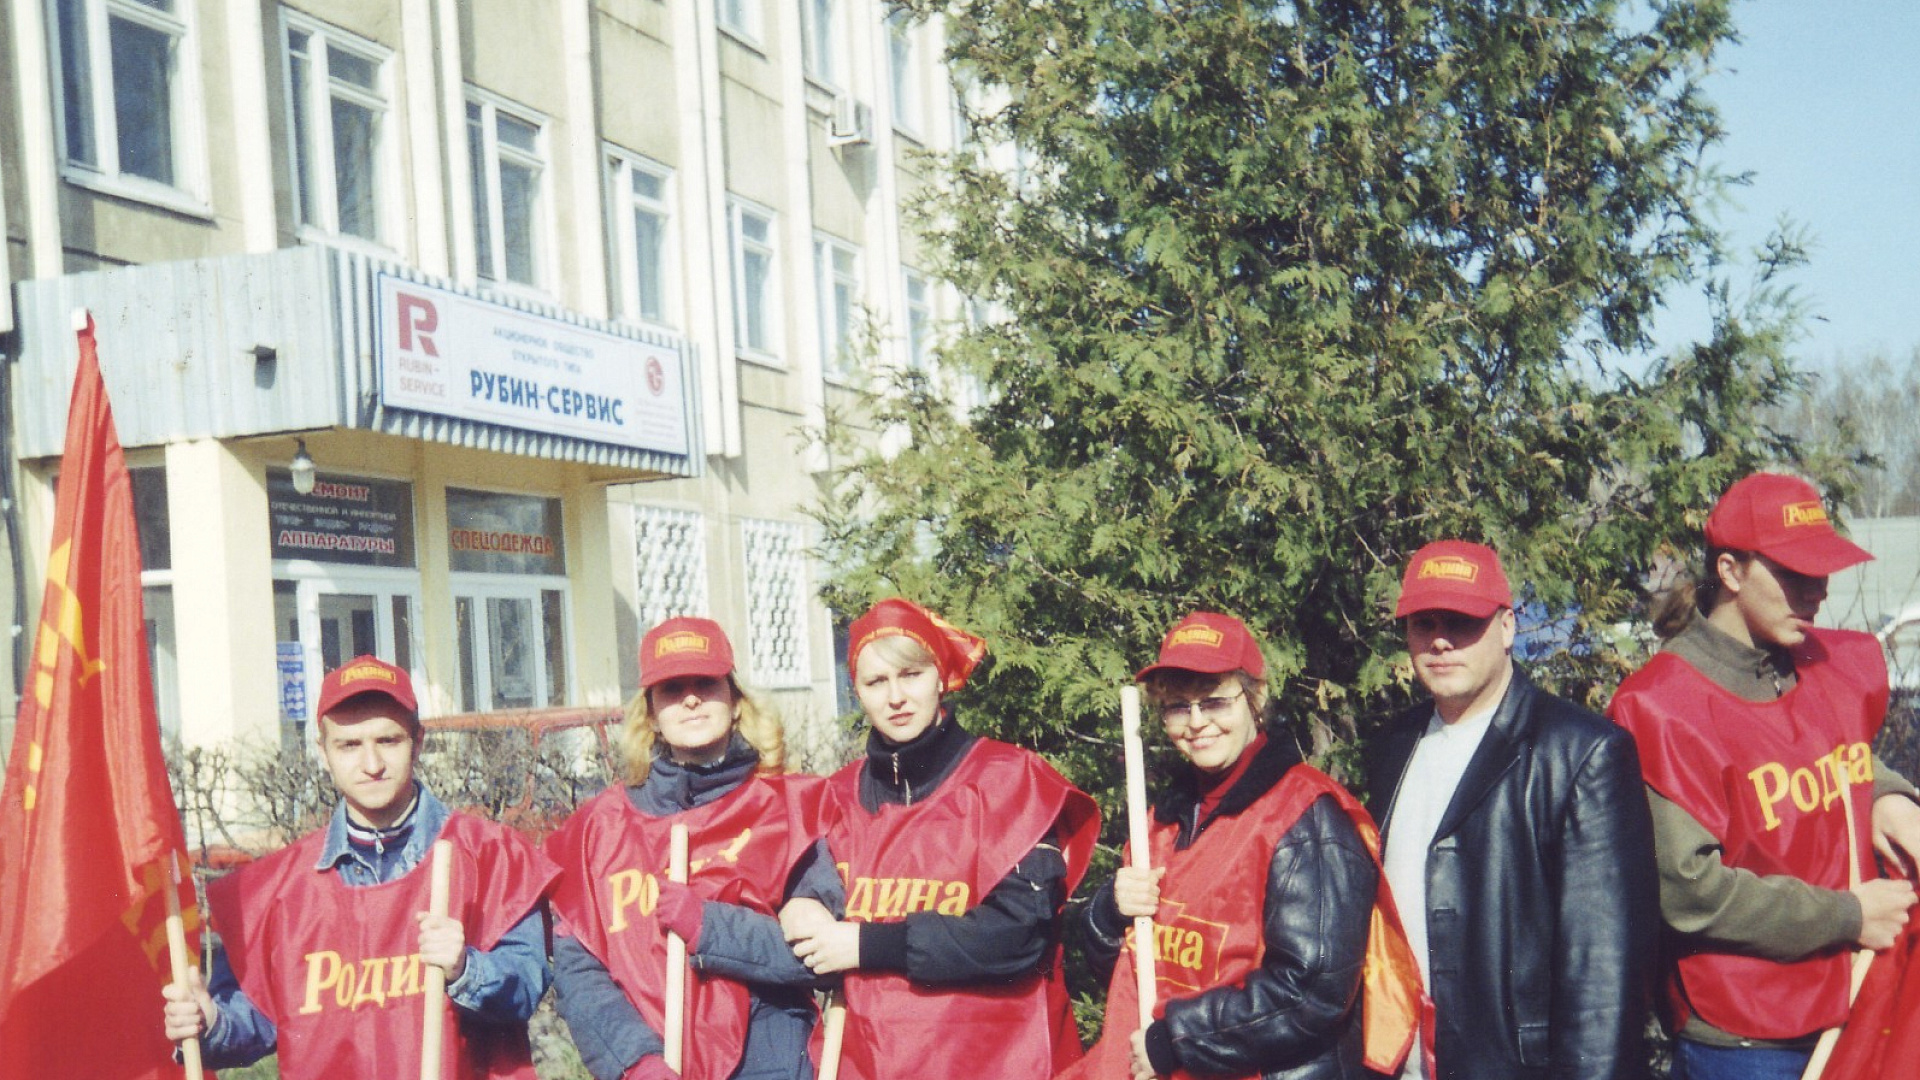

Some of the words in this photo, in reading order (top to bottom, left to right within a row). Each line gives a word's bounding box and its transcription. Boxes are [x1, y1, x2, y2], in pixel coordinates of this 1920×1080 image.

[400, 376, 446, 397] SERVICE
[469, 369, 624, 426] РУБИН-СЕРВИС
[311, 481, 369, 502] ЕМОНТ
[278, 530, 395, 554] АППАРАТУРЫ
[451, 528, 555, 557] СПЕЦОДЕЖДА
[299, 950, 427, 1015] Роди
